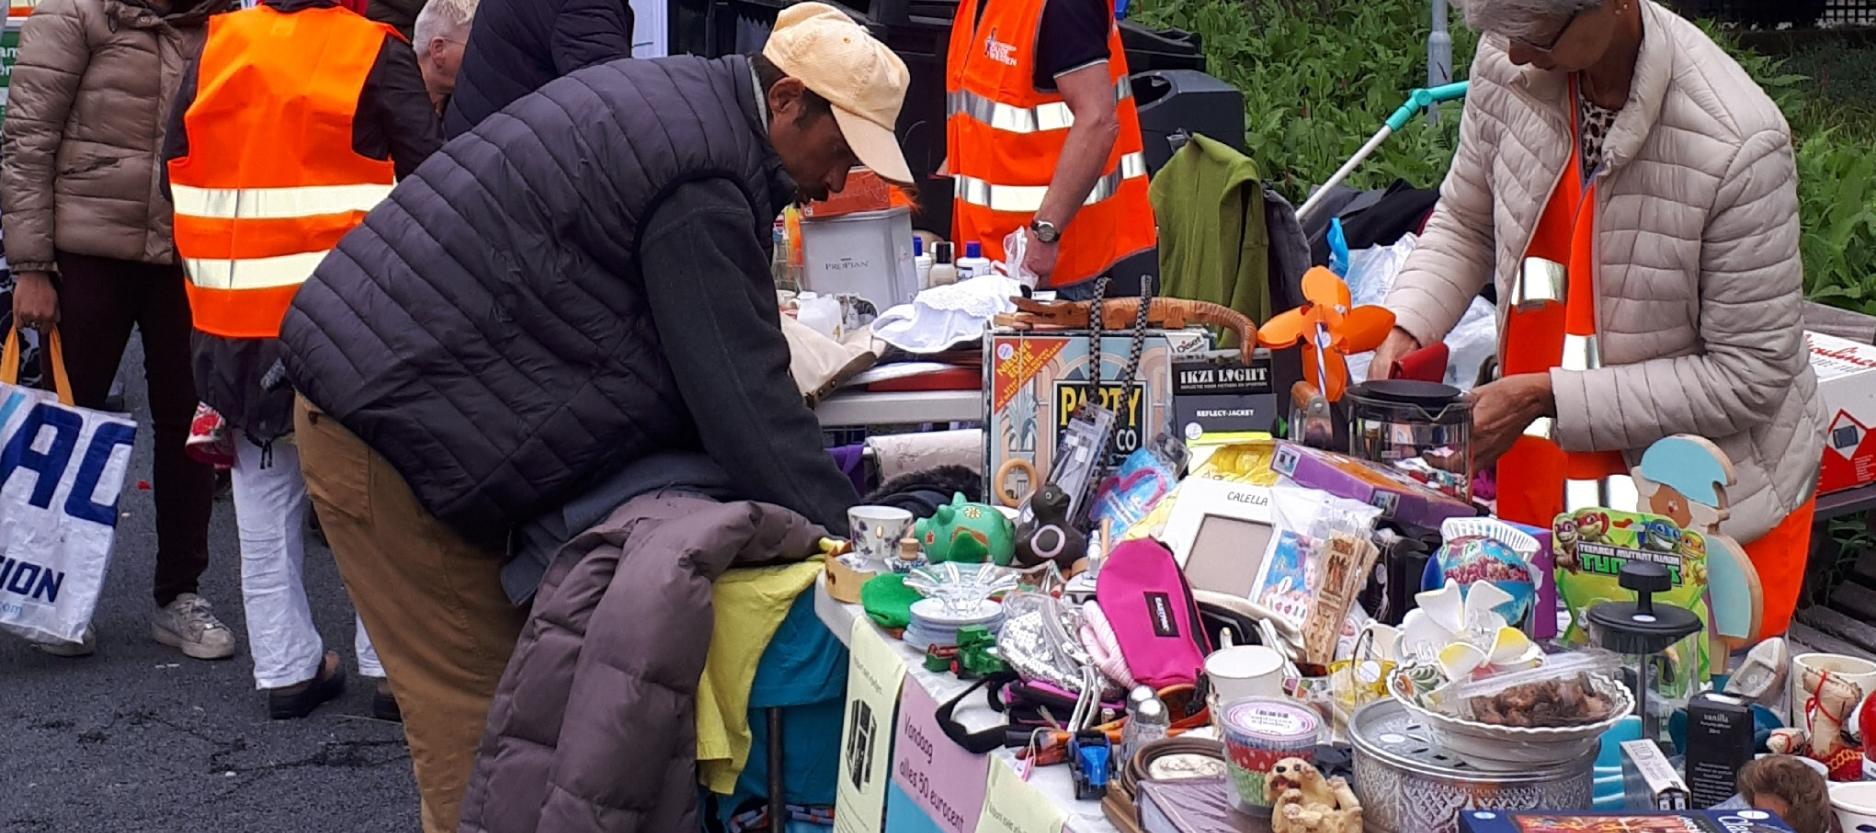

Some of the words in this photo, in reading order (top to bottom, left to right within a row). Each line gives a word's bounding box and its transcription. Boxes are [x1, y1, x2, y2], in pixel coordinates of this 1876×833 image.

[1116, 429, 1137, 451] CO
[1226, 491, 1269, 507] CALELLA
[904, 712, 933, 765] Vandaag
[899, 757, 917, 788] alles
[919, 771, 930, 799] 50
[930, 789, 964, 833] eurocent
